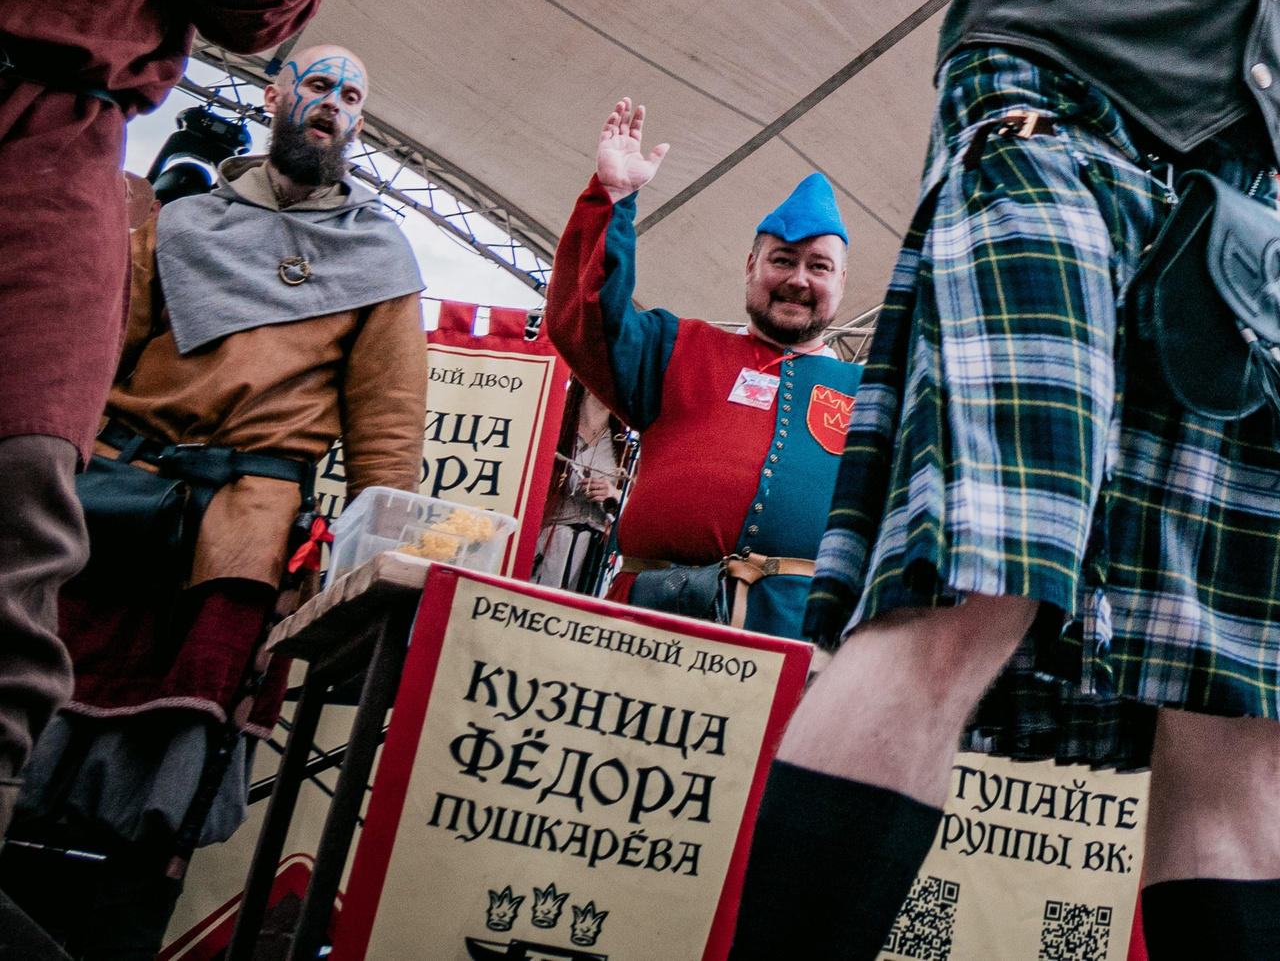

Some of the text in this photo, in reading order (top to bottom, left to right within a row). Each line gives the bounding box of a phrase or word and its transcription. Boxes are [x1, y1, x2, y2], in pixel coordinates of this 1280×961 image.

[469, 371, 523, 392] ДВОР
[471, 595, 759, 683] РЕМЕСЛЕННЫЙ ДВОР
[463, 660, 730, 758] КУЗНИЦА
[449, 722, 717, 823] ФЁДОРА
[427, 792, 704, 876] ПУШКАРЁВА
[1082, 841, 1134, 874] ВК:
